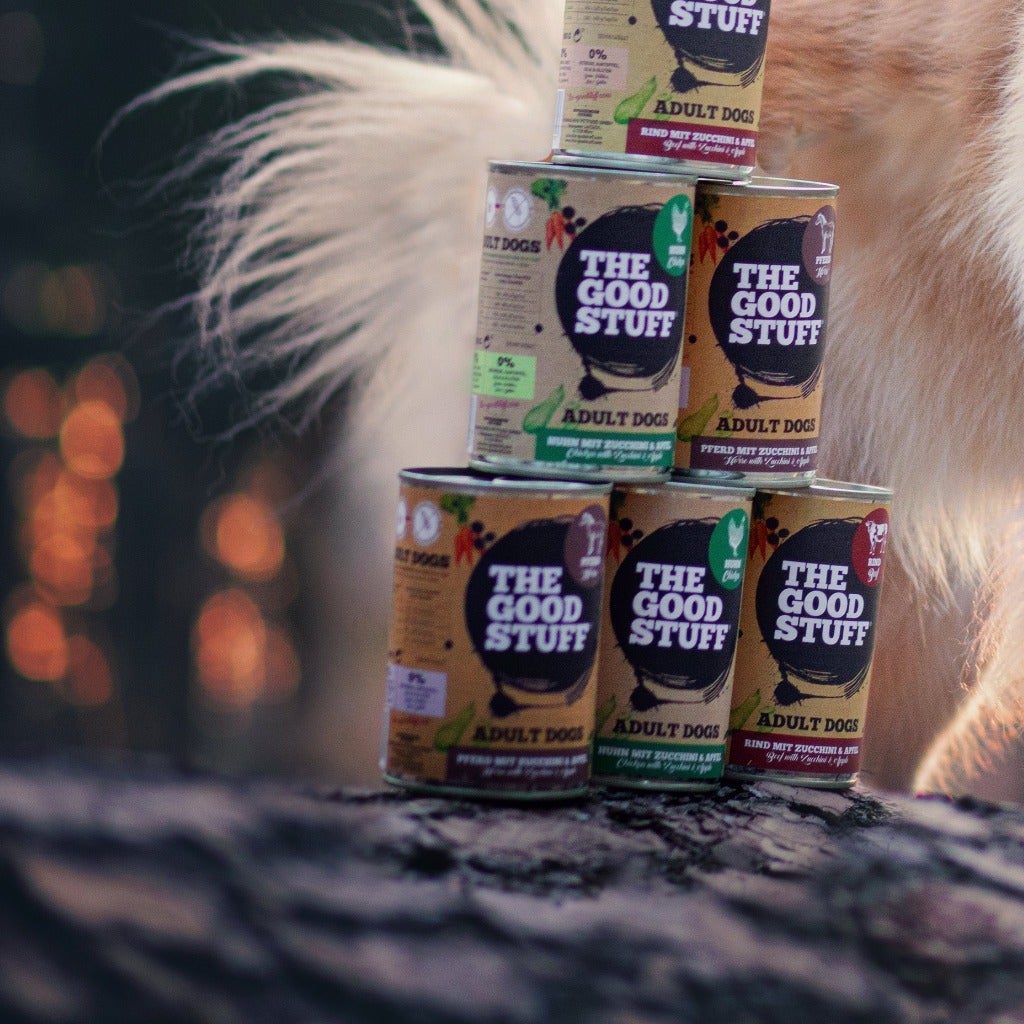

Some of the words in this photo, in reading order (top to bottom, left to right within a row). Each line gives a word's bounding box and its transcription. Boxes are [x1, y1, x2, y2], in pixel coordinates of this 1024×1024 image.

[668, 0, 765, 36] STUFF
[589, 49, 607, 60] 0%
[653, 100, 718, 121] ADULT
[722, 107, 755, 124] DOGS
[640, 127, 669, 138] RIND
[670, 130, 692, 141] MIT
[692, 132, 735, 145] ZUCCHINI
[502, 237, 541, 253] DOGS
[580, 249, 651, 280] THE
[733, 262, 800, 290] THE
[576, 278, 669, 309] GOOD
[730, 290, 816, 318] GOOD
[574, 306, 676, 338] STUFF
[728, 318, 822, 346] STUFF
[562, 408, 630, 427] ADULT
[632, 412, 669, 427] DOGS
[716, 417, 780, 434] ADULT
[784, 418, 816, 434] DOGS
[700, 444, 734, 454] PFERD
[736, 446, 758, 455] MIT
[758, 448, 799, 456] ZUCCHINI
[488, 564, 563, 594] THE
[636, 562, 706, 593] THE
[782, 560, 849, 591] THE
[486, 594, 583, 624] GOOD
[632, 591, 724, 623] GOOD
[777, 588, 864, 620] GOOD
[484, 623, 591, 652] STUFF
[628, 618, 731, 651] STUFF
[774, 615, 870, 646] STUFF
[473, 726, 542, 743] ADULT
[613, 719, 678, 738] ADULT
[683, 724, 720, 740] DOGS
[756, 712, 822, 732] ADULT
[824, 717, 858, 733] DOGS
[631, 749, 653, 760] MIT
[654, 750, 699, 762] ZUCCHINI
[744, 739, 771, 750] RIND
[772, 742, 794, 752] MIT
[794, 744, 838, 755] ZUCCHINI
[838, 746, 843, 754] &
[784, 752, 799, 762] with
